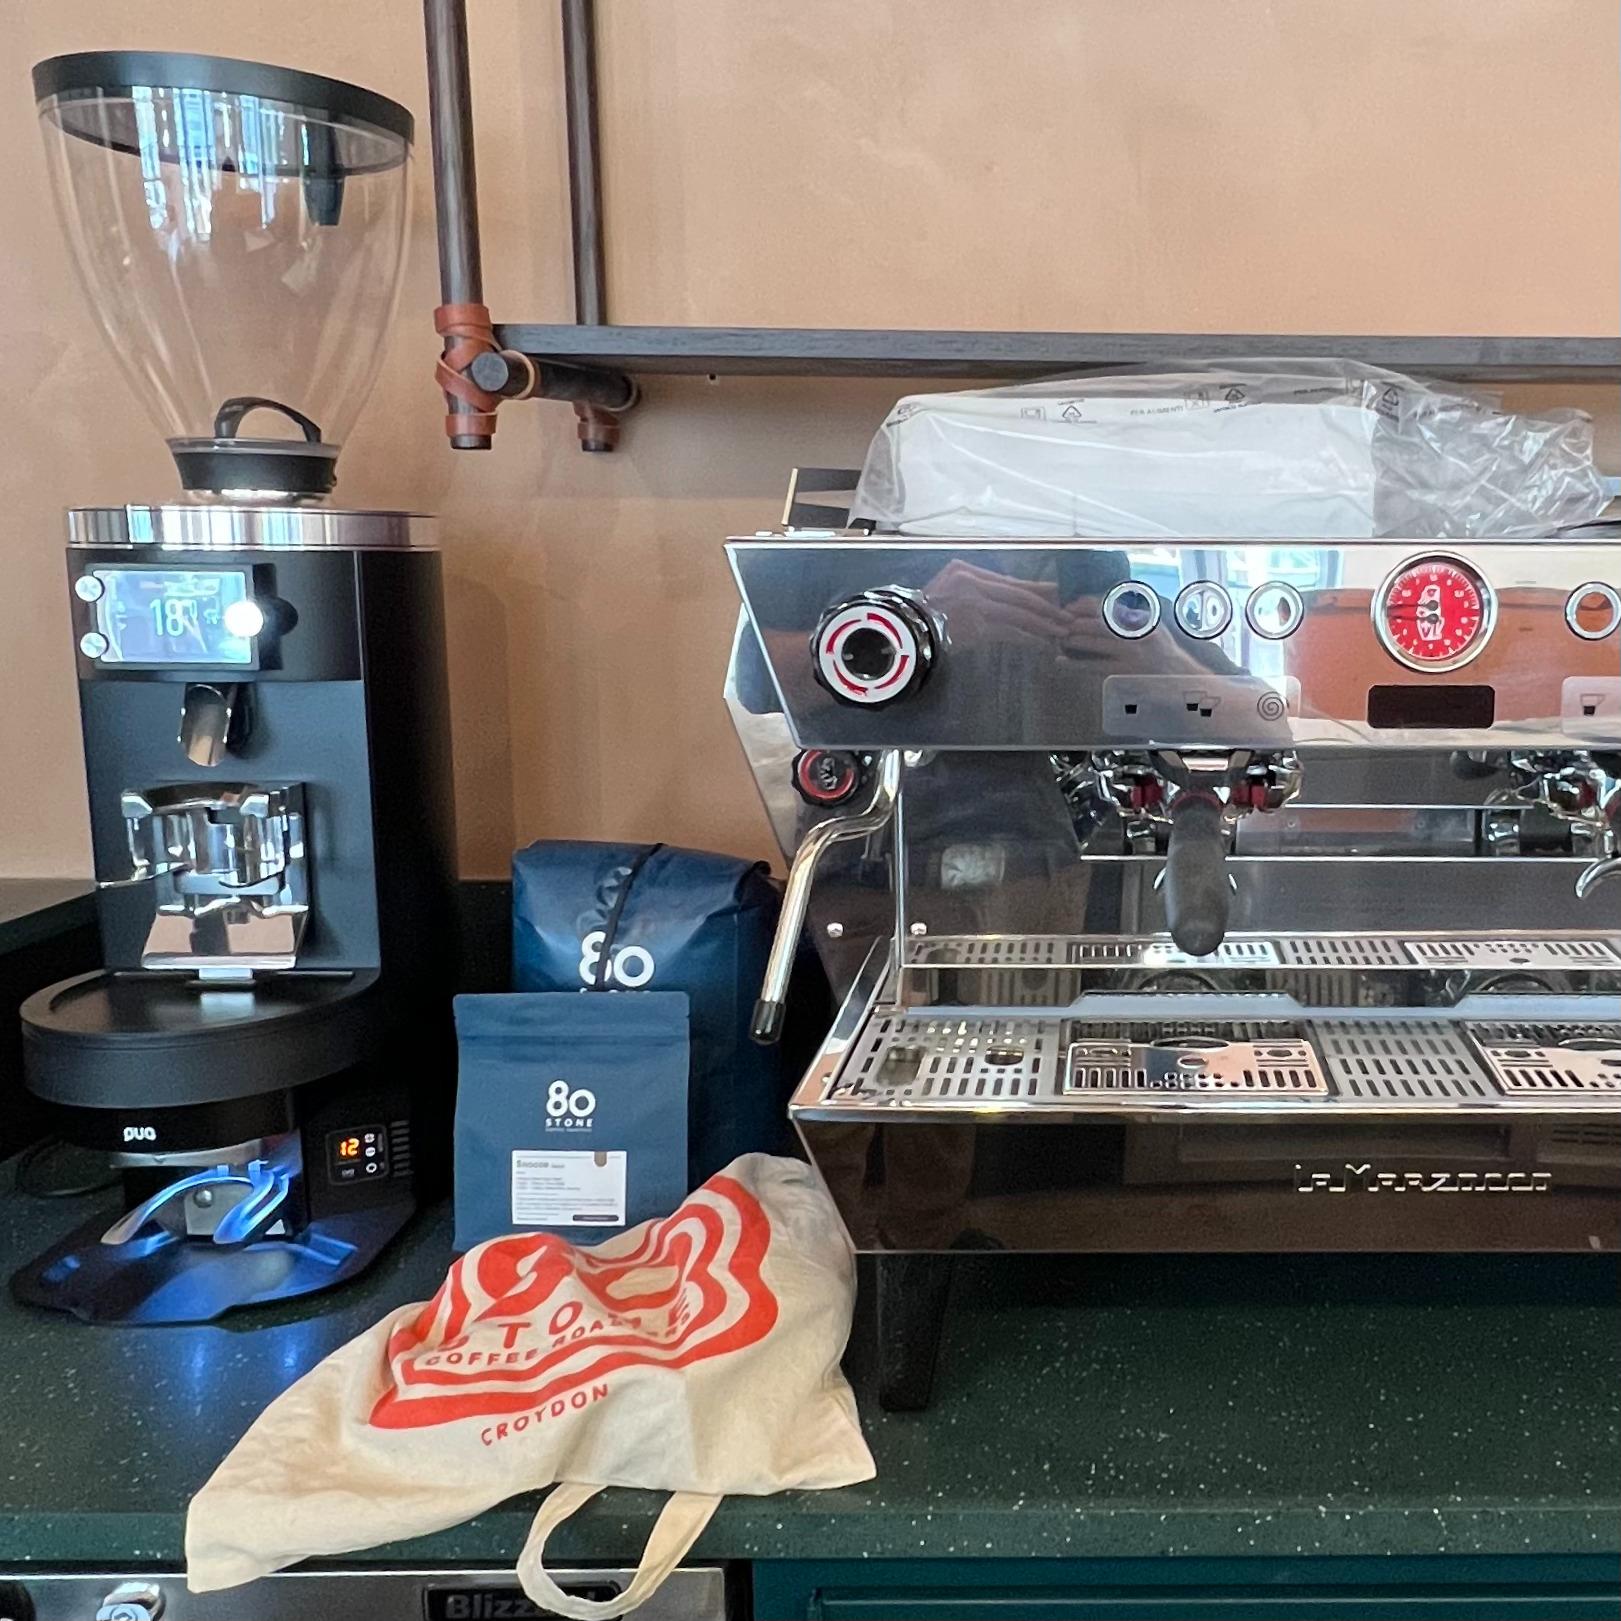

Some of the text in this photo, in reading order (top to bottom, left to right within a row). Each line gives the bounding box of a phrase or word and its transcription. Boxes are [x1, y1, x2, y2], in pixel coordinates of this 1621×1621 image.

[579, 930, 655, 988] 80
[546, 1080, 596, 1117] 80
[545, 1118, 593, 1128] STONE
[340, 1138, 360, 1156] 12
[426, 1348, 539, 1366] COFFEE
[481, 1383, 609, 1446] CROYDON
